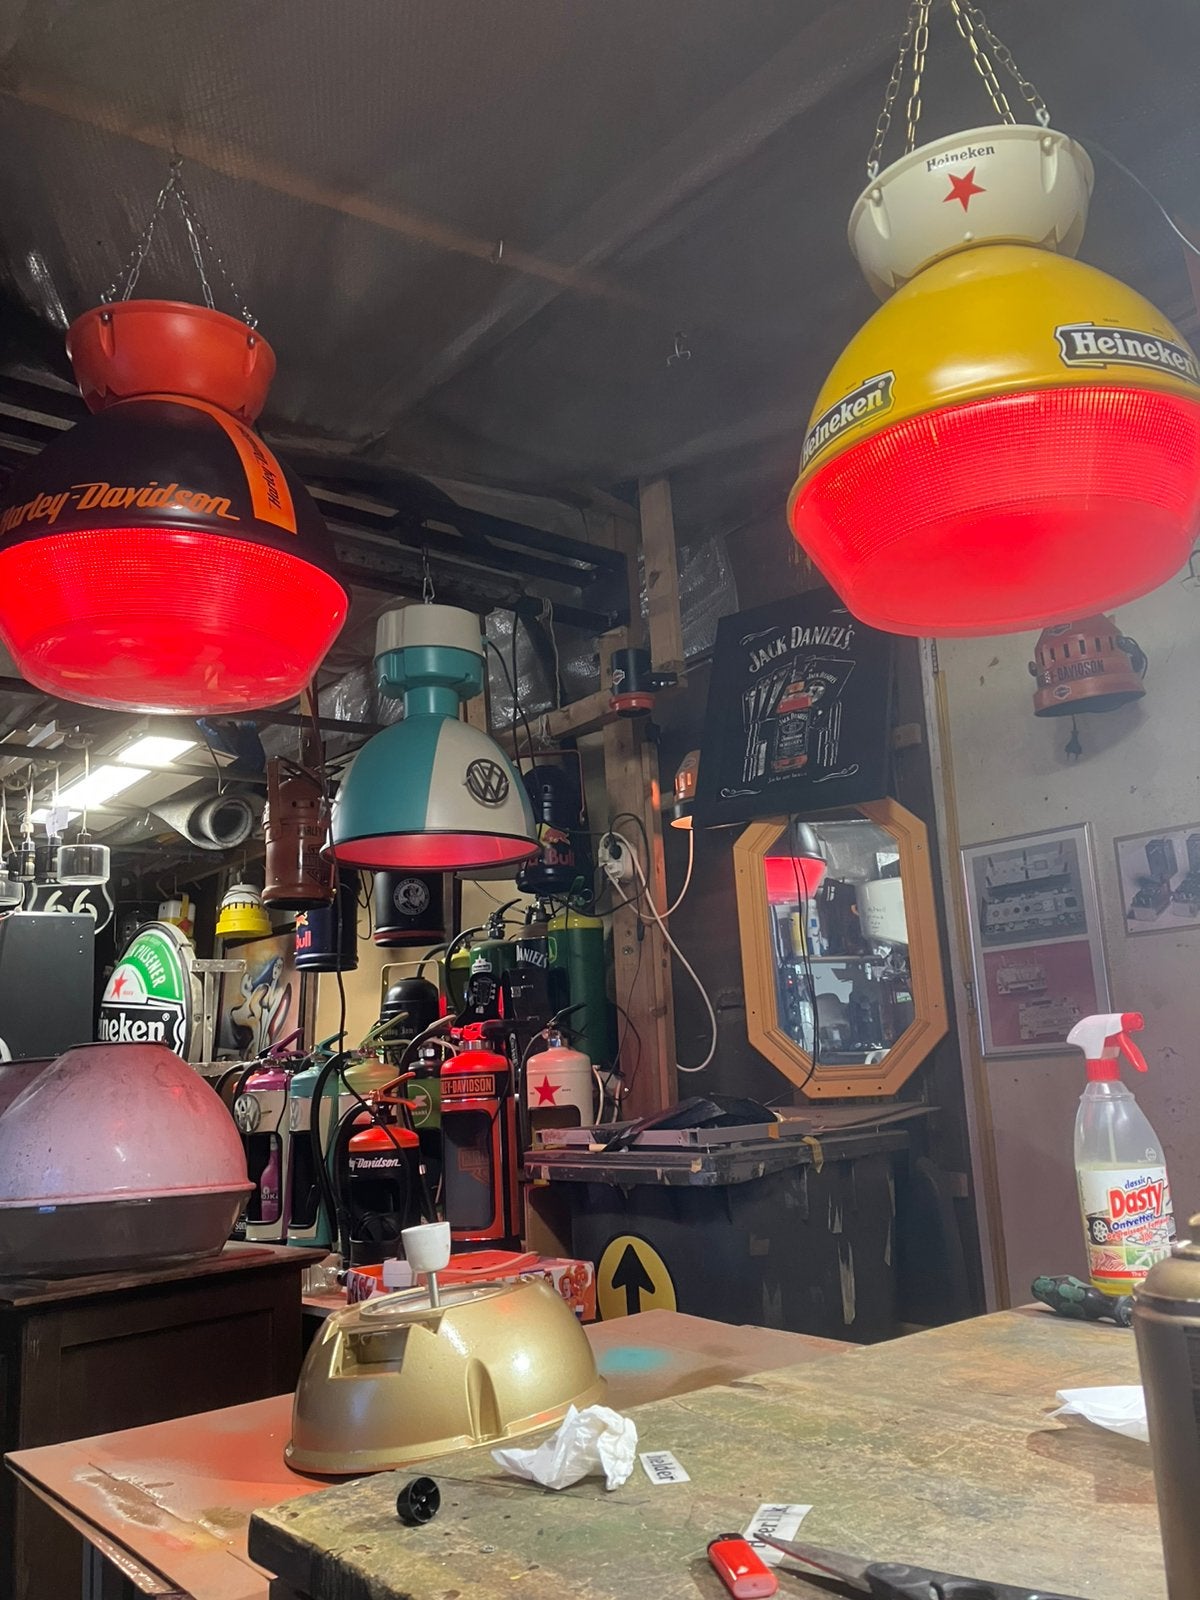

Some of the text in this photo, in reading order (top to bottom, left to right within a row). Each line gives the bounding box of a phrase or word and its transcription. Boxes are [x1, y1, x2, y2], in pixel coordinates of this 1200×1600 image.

[926, 145, 995, 172] Heineken
[1070, 331, 1199, 379] Heineken
[802, 388, 884, 468] Heineken
[0, 481, 241, 536] Harley-Davidson
[749, 624, 856, 673] JACK DANIEL'S
[1108, 1181, 1164, 1220] Dasty
[1125, 1175, 1146, 1190] classic
[1112, 1213, 1154, 1231] Ontvetter
